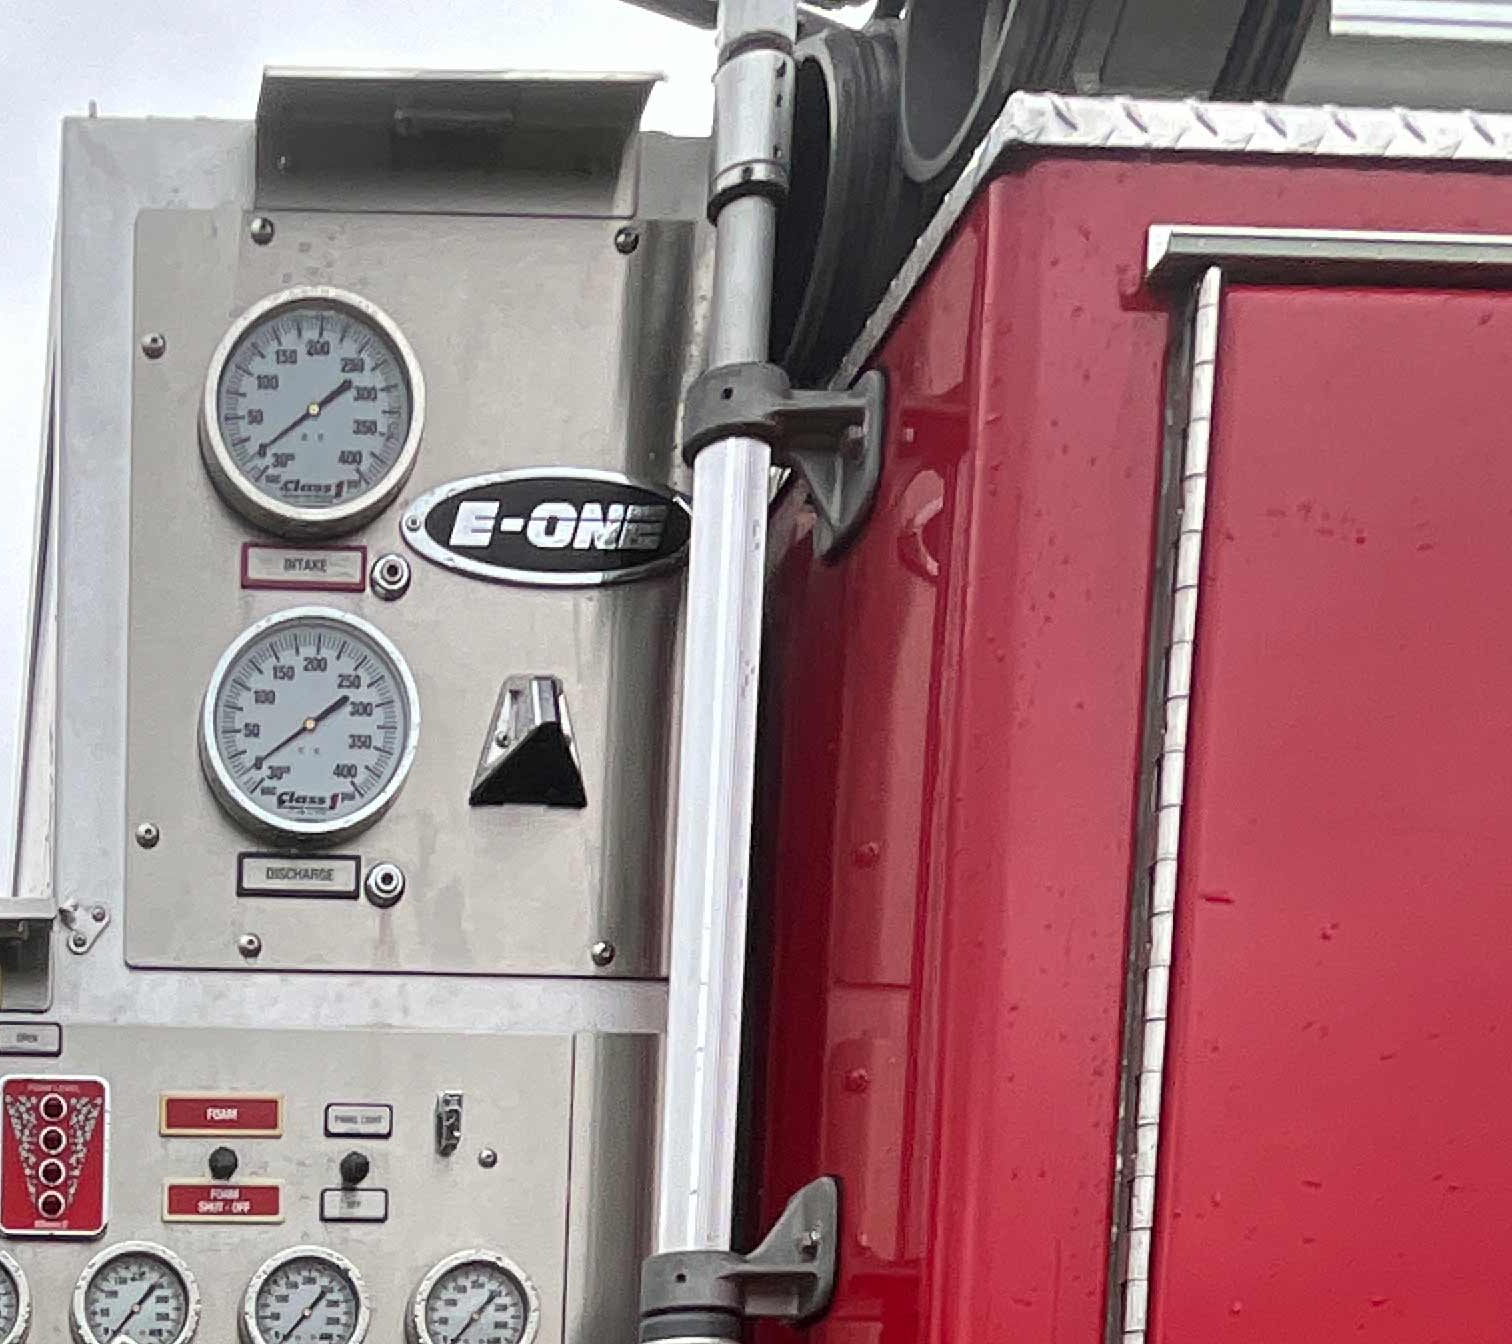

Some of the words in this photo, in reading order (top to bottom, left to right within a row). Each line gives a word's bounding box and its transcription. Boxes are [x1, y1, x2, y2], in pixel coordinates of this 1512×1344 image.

[275, 348, 298, 365] 150
[305, 340, 330, 357] 200
[256, 374, 279, 391] 100
[247, 408, 264, 425] 50
[338, 450, 363, 466] 400
[448, 500, 668, 550] E-ONE
[283, 558, 328, 573] INTAKE
[303, 656, 328, 672] 200
[272, 665, 295, 681] 150
[337, 674, 361, 690] 250
[254, 690, 276, 705] 100
[349, 701, 374, 717] 300
[243, 722, 260, 738] 50
[348, 734, 372, 750] 350
[332, 763, 358, 779] 400
[266, 866, 335, 882] DISCHARGE
[206, 1108, 238, 1121] FOAM
[210, 1188, 240, 1199] FOAM
